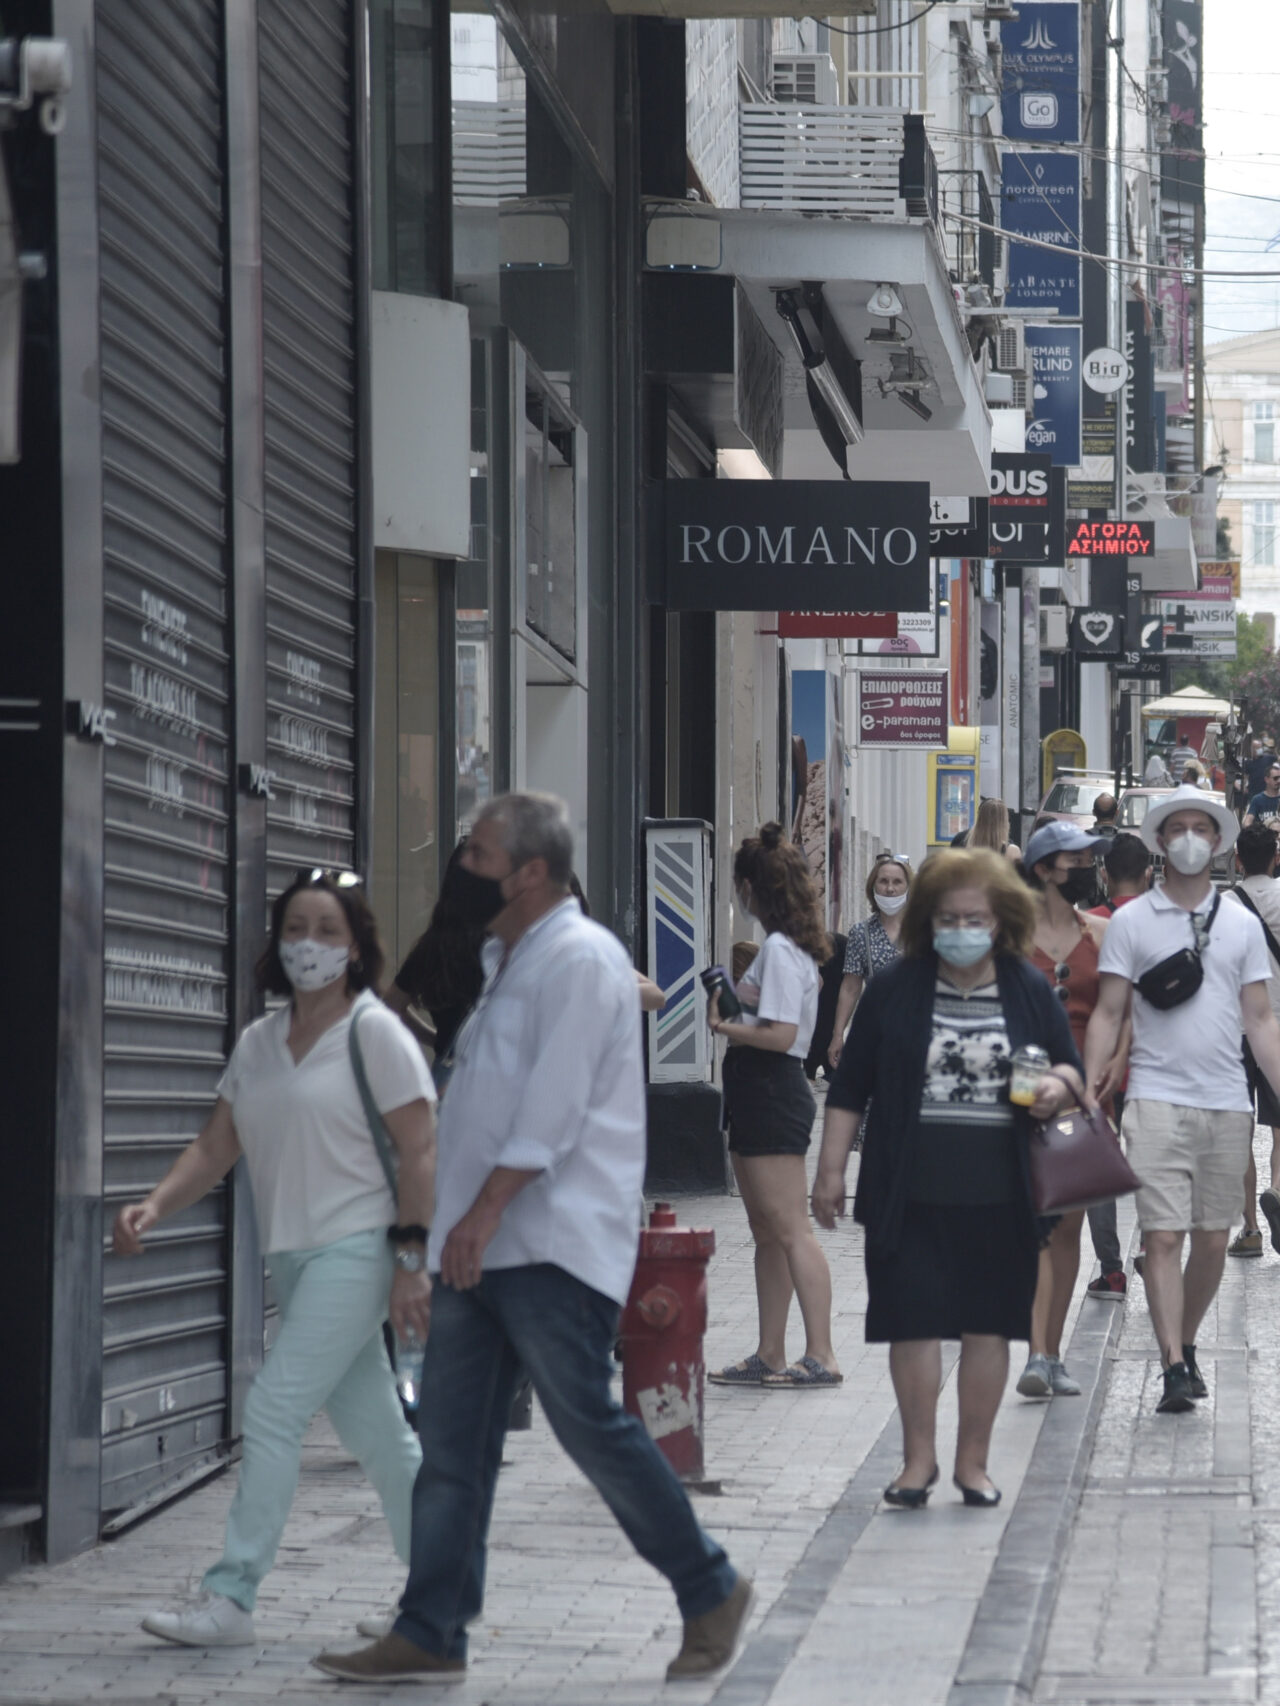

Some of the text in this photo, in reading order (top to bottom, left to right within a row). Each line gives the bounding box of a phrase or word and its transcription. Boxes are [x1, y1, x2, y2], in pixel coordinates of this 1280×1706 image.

[1026, 54, 1074, 63] OLYMPUS
[1027, 100, 1050, 116] Go
[1006, 185, 1074, 195] nordgreen
[1017, 289, 1061, 297] LONDON
[1089, 361, 1121, 378] Big
[1077, 523, 1142, 538] ΑΓΟΡΑ
[679, 524, 918, 567] ROMANO
[1068, 539, 1151, 554] ΑΣΗΜΙΟΥ
[862, 681, 943, 694] ΕΠΙΔΙΟΡΘΩΣΕΙΣ
[900, 696, 942, 708] ρούχων
[1009, 673, 1018, 729] ANATOMIC
[861, 714, 941, 730] e-paramana
